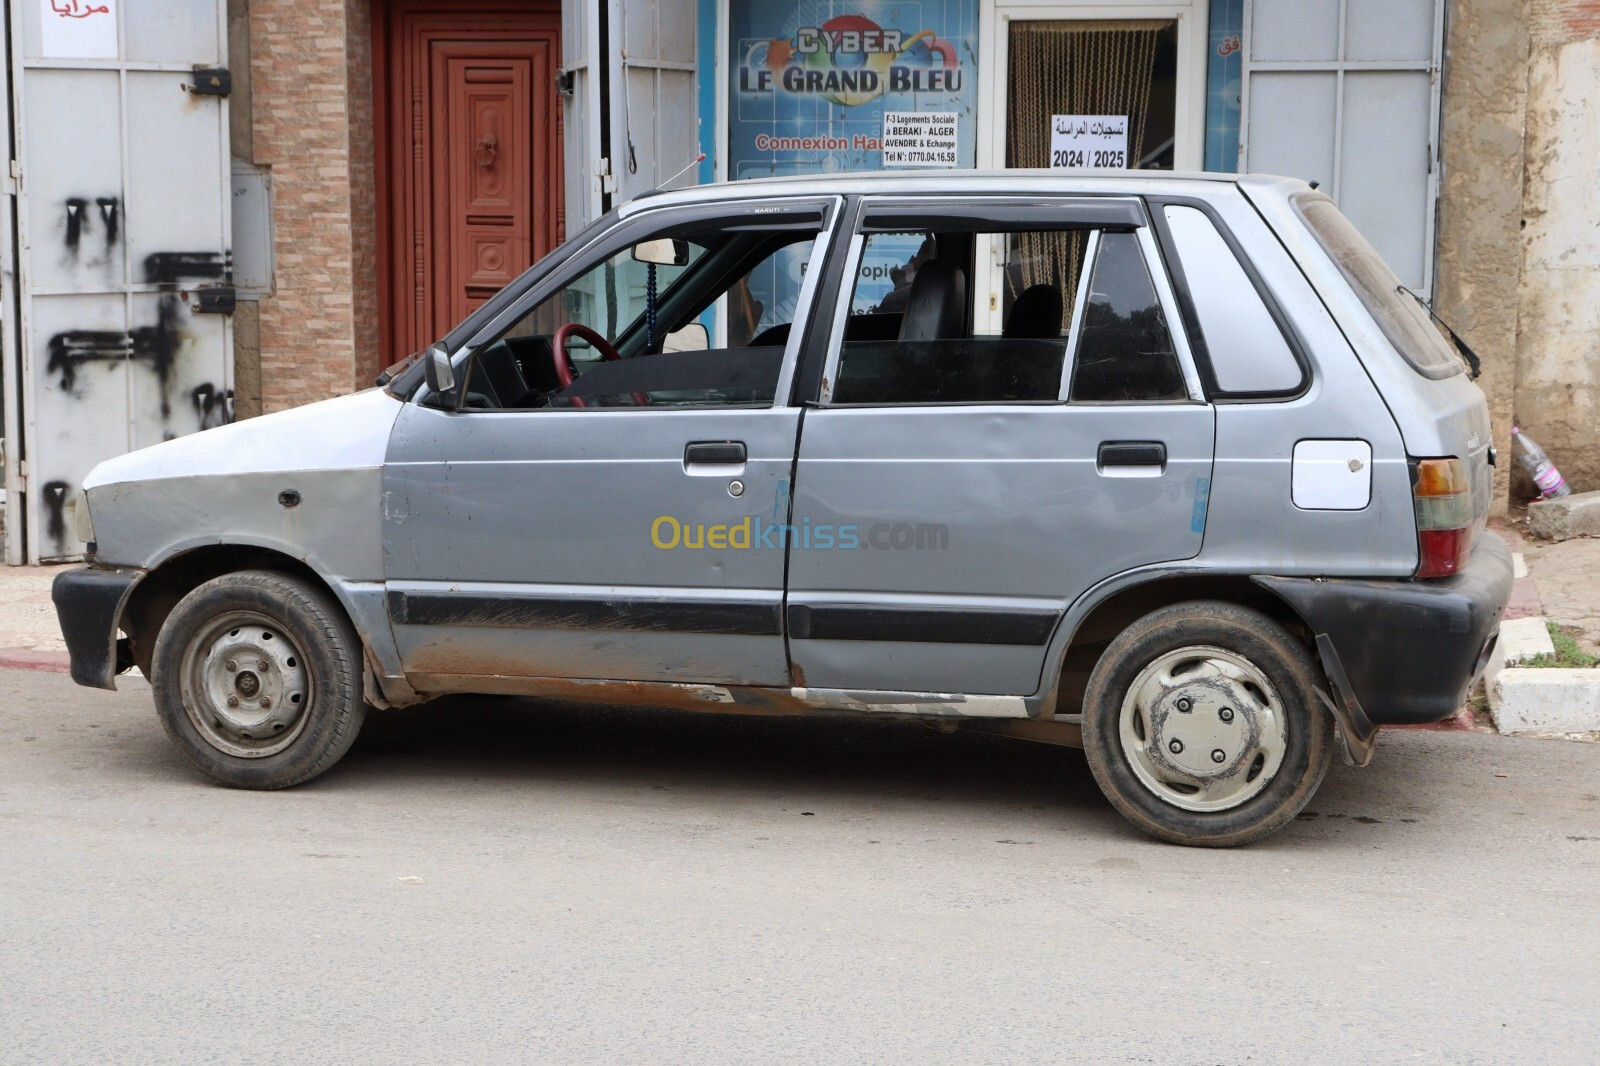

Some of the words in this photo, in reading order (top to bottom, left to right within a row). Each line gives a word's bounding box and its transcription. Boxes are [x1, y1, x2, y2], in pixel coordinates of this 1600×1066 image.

[50, 0, 109, 18] مرايا
[797, 26, 902, 54] CYBER
[739, 67, 772, 93] LE
[783, 66, 878, 93] GRAND
[889, 66, 961, 93] BLEU
[886, 114, 896, 123] F-3
[897, 114, 931, 125] Logements
[932, 115, 955, 124] Sociale
[893, 127, 922, 136] BERAKI
[928, 127, 955, 136] ALGER
[1056, 118, 1088, 140] المراسلة
[1090, 121, 1124, 140] تسجيلات
[756, 134, 848, 151] Connexion
[885, 139, 918, 147] AVENDRE
[919, 139, 925, 147] &
[926, 139, 955, 149] Echange
[885, 151, 896, 162] Tél
[908, 151, 955, 162] 0770.04.16.58
[1053, 149, 1084, 168] 2024
[1094, 150, 1124, 168] 2025
